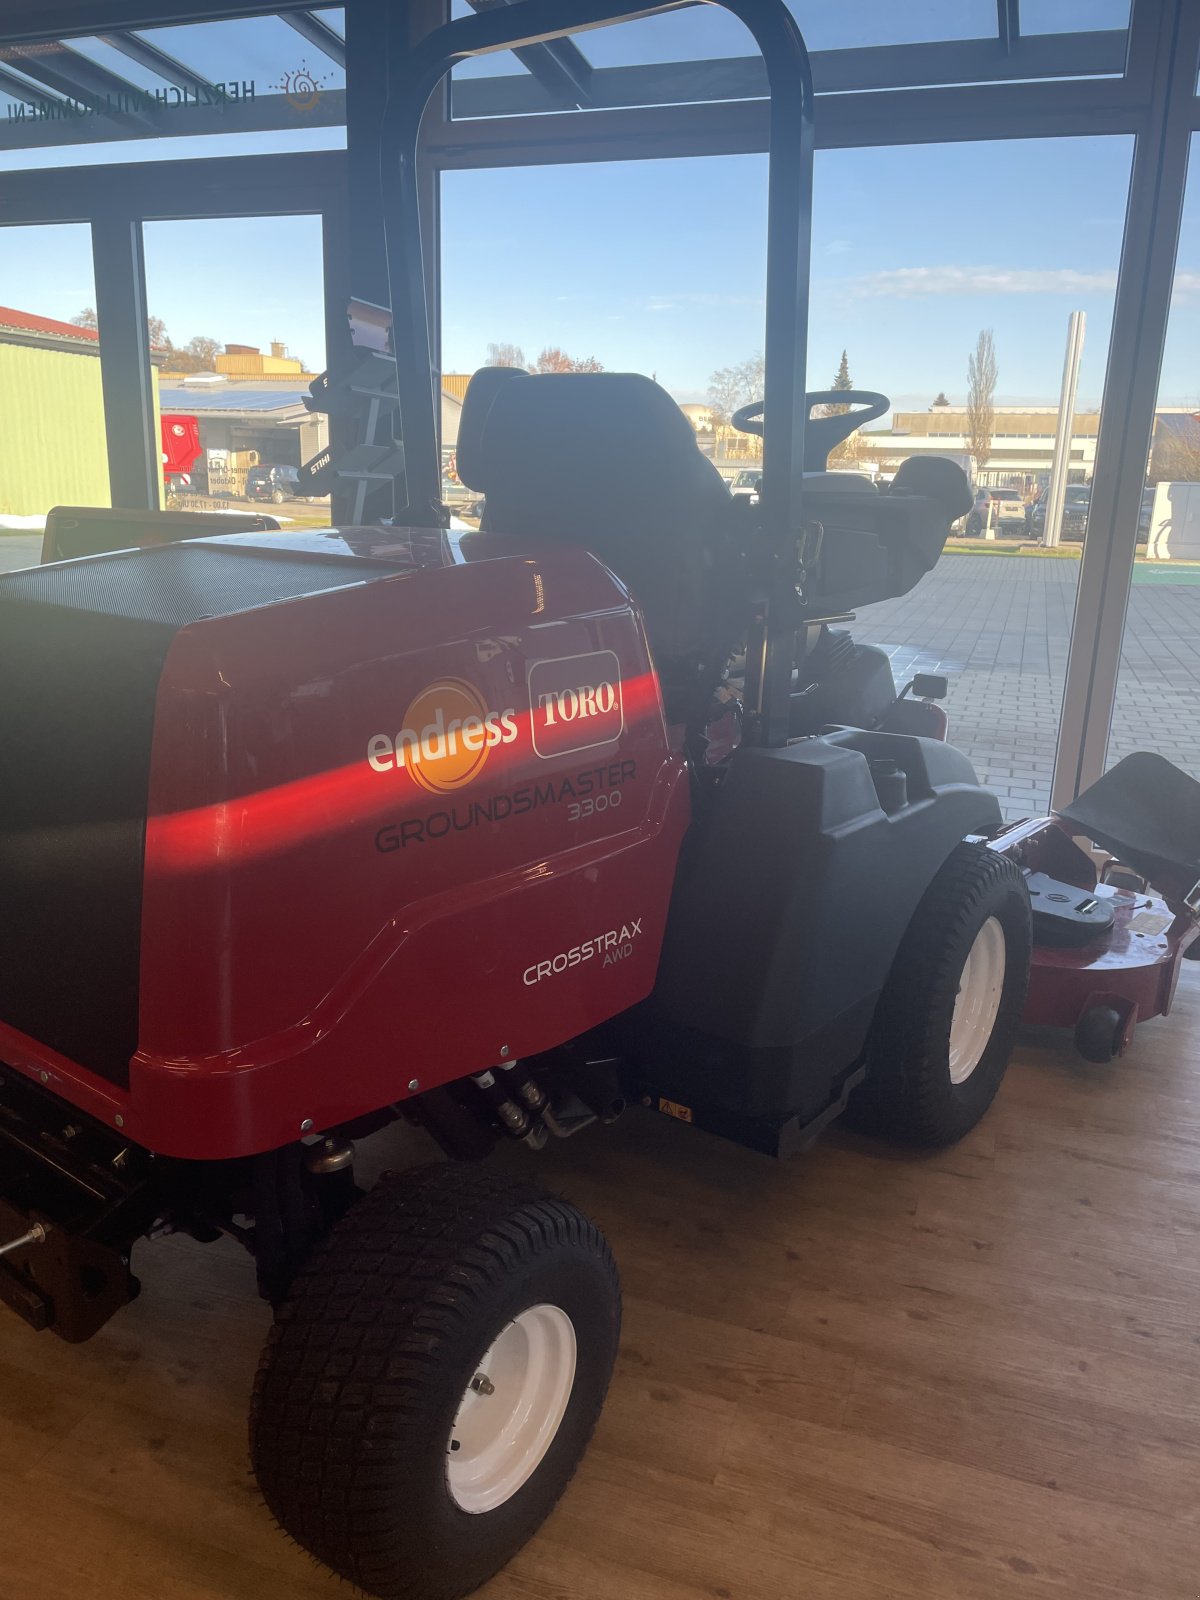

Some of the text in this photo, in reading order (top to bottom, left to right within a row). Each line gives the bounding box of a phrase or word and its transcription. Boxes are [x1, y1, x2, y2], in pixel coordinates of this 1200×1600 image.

[538, 681, 615, 726] TORO
[367, 708, 518, 772] endress
[375, 759, 637, 854] GROUNDSMASTER
[567, 790, 622, 822] 3300
[523, 917, 642, 986] CROSSTRAX
[603, 943, 633, 969] AWD
